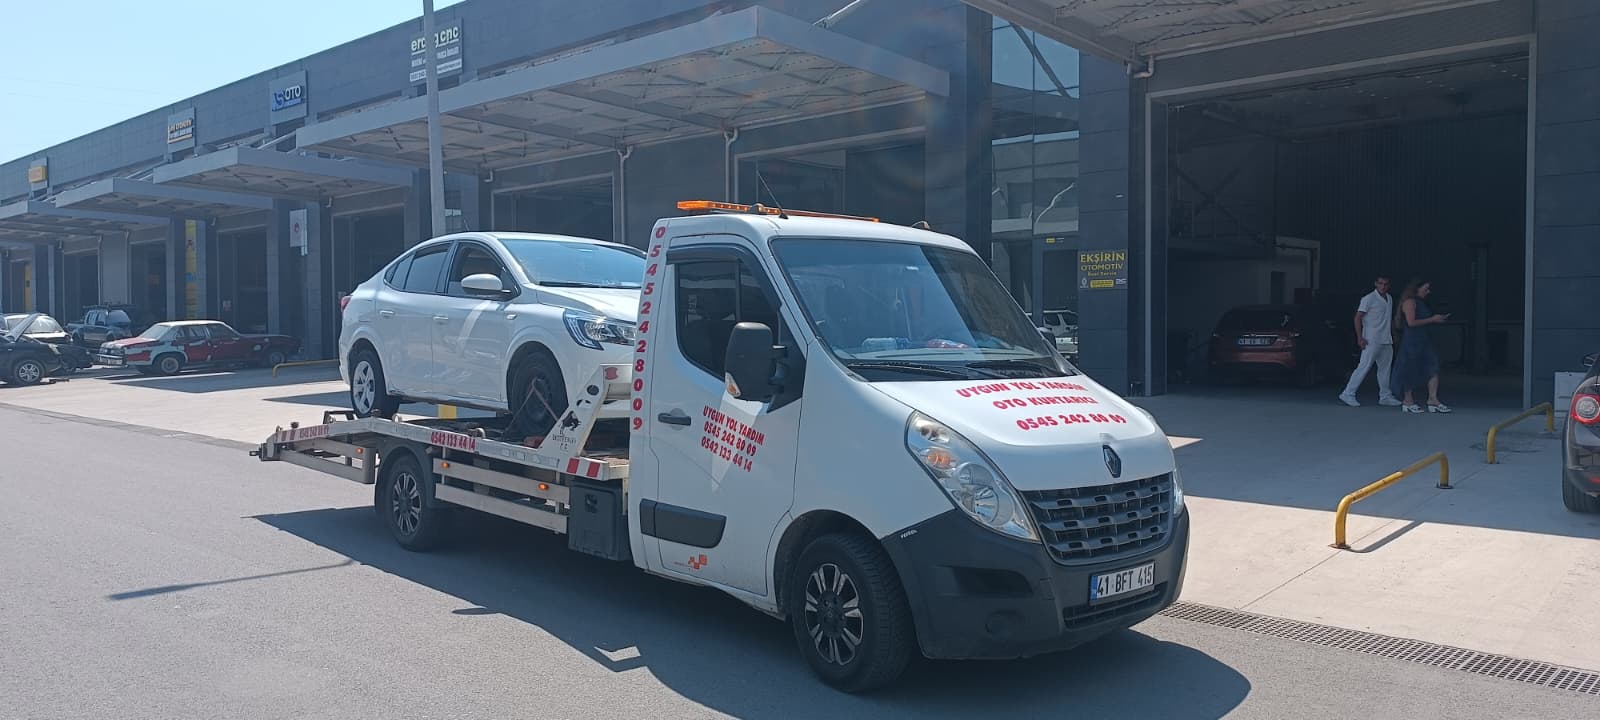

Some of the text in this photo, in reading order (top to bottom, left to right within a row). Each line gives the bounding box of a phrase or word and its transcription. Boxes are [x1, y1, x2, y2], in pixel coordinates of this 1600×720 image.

[440, 26, 459, 43] cnc
[285, 85, 301, 100] OTO
[1080, 251, 1125, 263] EKŞİRİN
[1081, 262, 1123, 271] OTOMOTİV
[955, 381, 1088, 398] UYGUN YOL YARDIM
[992, 396, 1099, 409] OTO KURTARICI
[703, 405, 765, 446] UYGUN YOL YARDIM
[1016, 413, 1128, 431] 0545 242 80 09
[704, 421, 757, 457] 0545 242 80 09
[701, 436, 753, 472] 0542 133 44 14
[1097, 565, 1153, 596] 41 BFT 415
